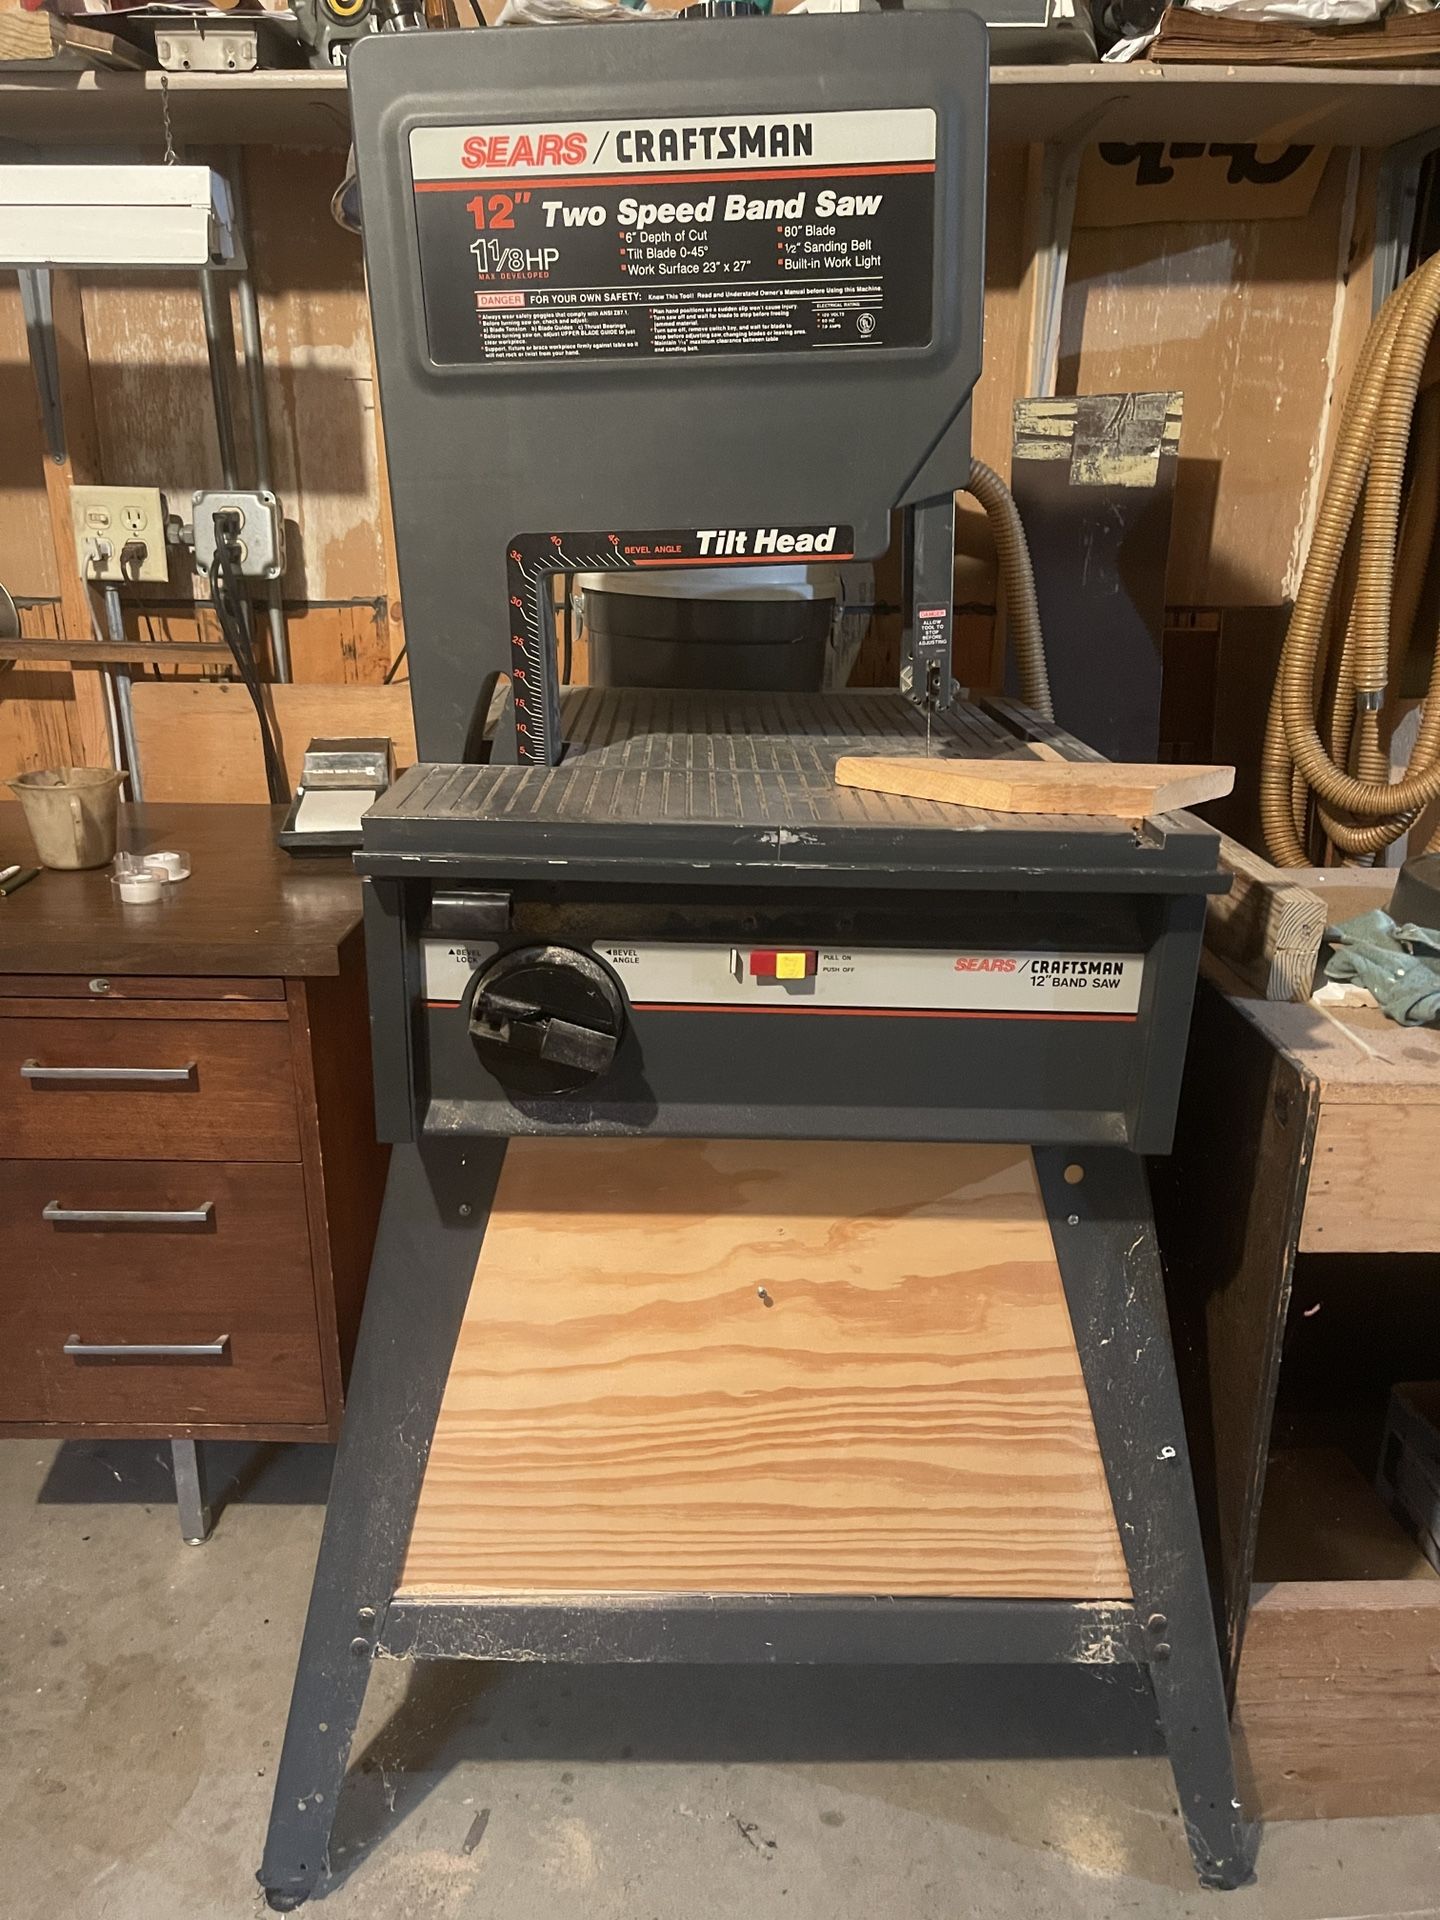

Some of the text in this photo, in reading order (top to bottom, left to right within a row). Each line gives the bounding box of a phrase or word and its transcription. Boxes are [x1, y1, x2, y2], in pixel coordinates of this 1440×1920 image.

[462, 132, 588, 168] SEARS
[616, 123, 812, 163] CRAFTSMAN
[542, 201, 606, 228] Two
[617, 195, 715, 229] Speed
[724, 192, 806, 221] Band
[815, 190, 882, 217] Saw
[640, 232, 671, 244] Depth
[675, 231, 686, 242] of
[689, 229, 707, 241] Cut
[806, 225, 835, 236] Blade
[804, 240, 847, 254] Sanding
[852, 239, 872, 251] Belt
[627, 248, 643, 260] Tilt
[647, 246, 676, 258] Blade
[628, 264, 655, 276] Work
[658, 262, 699, 275] Surface
[724, 264, 730, 272] x
[784, 256, 881, 270] Built-in Work Light
[501, 272, 550, 280] DEVELOPED
[480, 296, 521, 305] DANGER
[530, 295, 549, 304] FOR
[552, 294, 577, 303] YOUR
[580, 293, 602, 302] OWN
[604, 292, 642, 302] SAFETY:
[550, 535, 562, 547] 40
[607, 533, 620, 546] 45
[696, 527, 836, 555] Tilt Head
[654, 545, 682, 553] ANGLE
[509, 550, 522, 562] 35
[510, 596, 522, 608] 30
[512, 636, 524, 646] 25
[513, 669, 525, 679] 20
[515, 698, 525, 707] 15
[516, 724, 527, 732] 10
[955, 957, 1016, 972] SEARS
[1031, 961, 1123, 975] CRAFTSMAN
[1053, 978, 1087, 987] BAND
[1092, 979, 1120, 988] SAW
